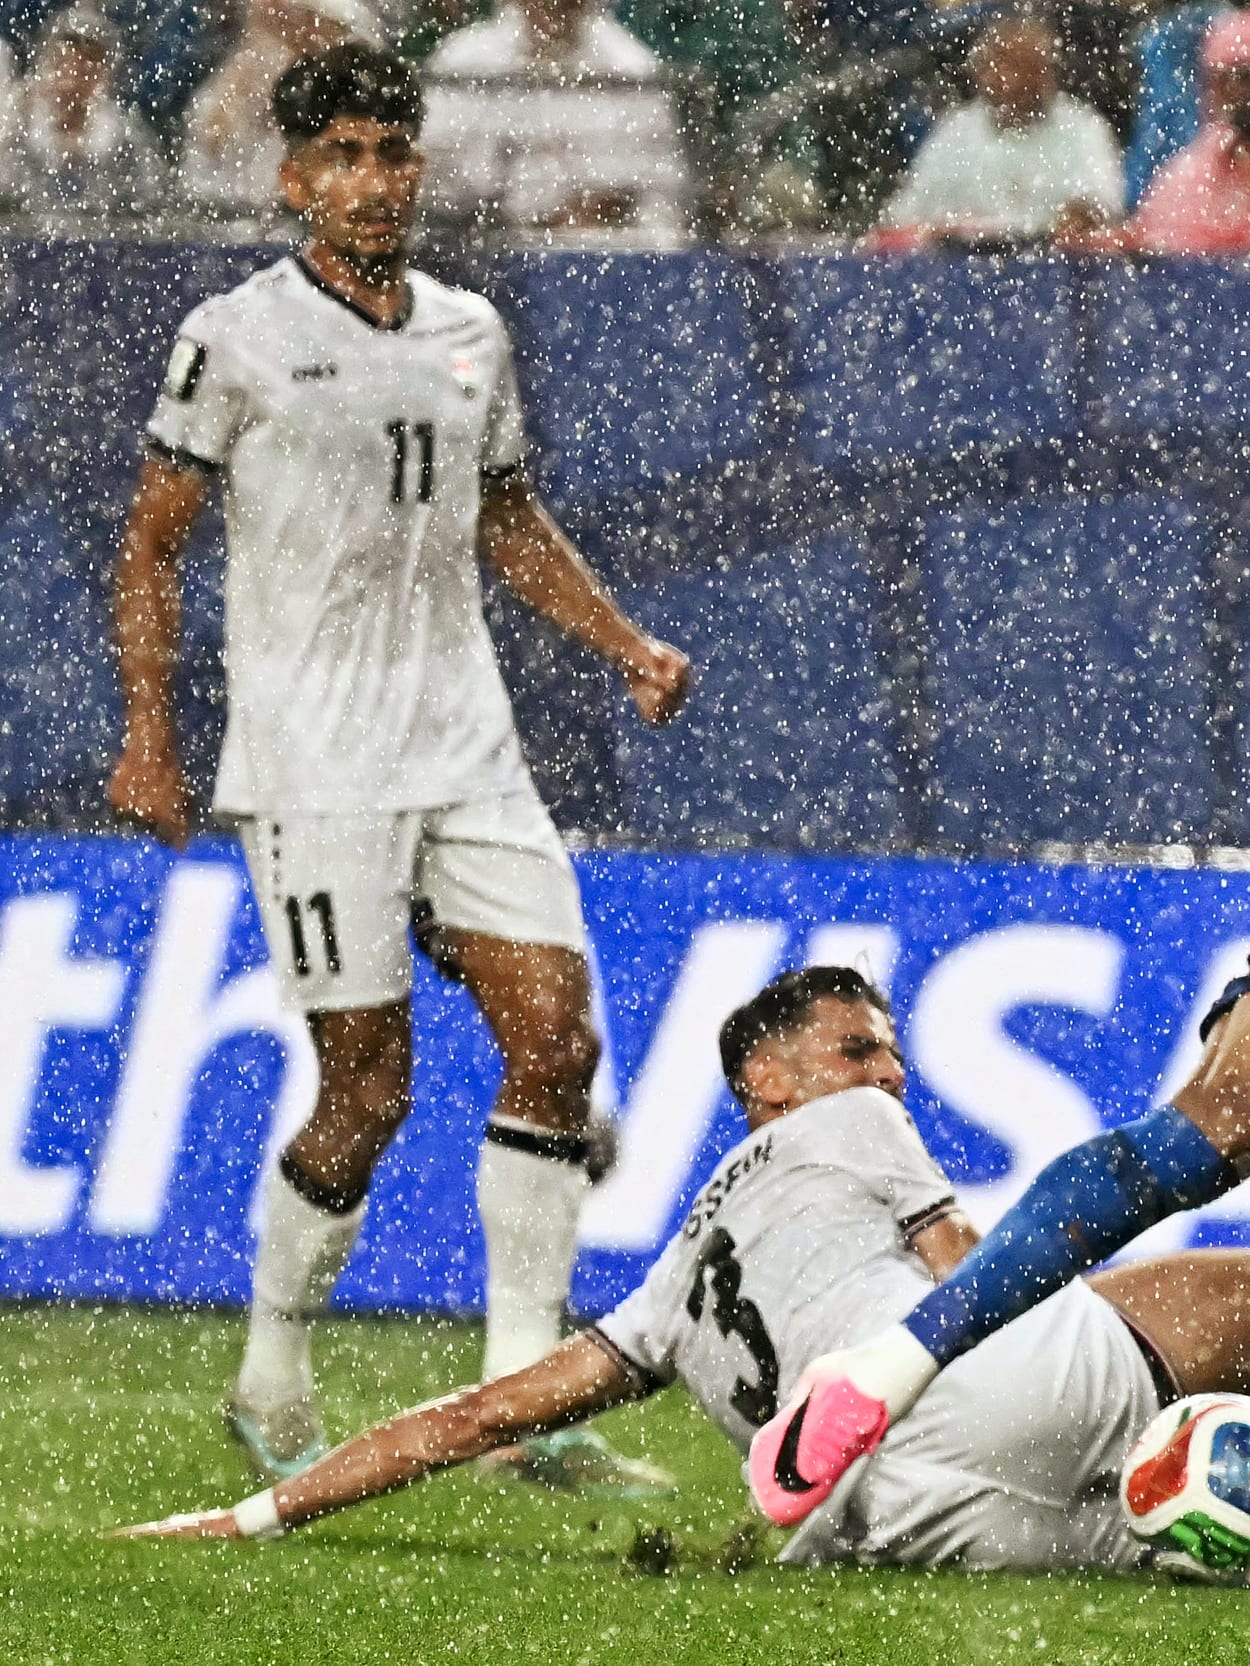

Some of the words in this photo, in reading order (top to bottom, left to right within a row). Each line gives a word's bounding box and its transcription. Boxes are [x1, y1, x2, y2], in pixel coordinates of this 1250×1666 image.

[384, 418, 434, 504] 11
[286, 889, 341, 977] 11
[0, 860, 321, 1237] th
[687, 1226, 779, 1427] 3
